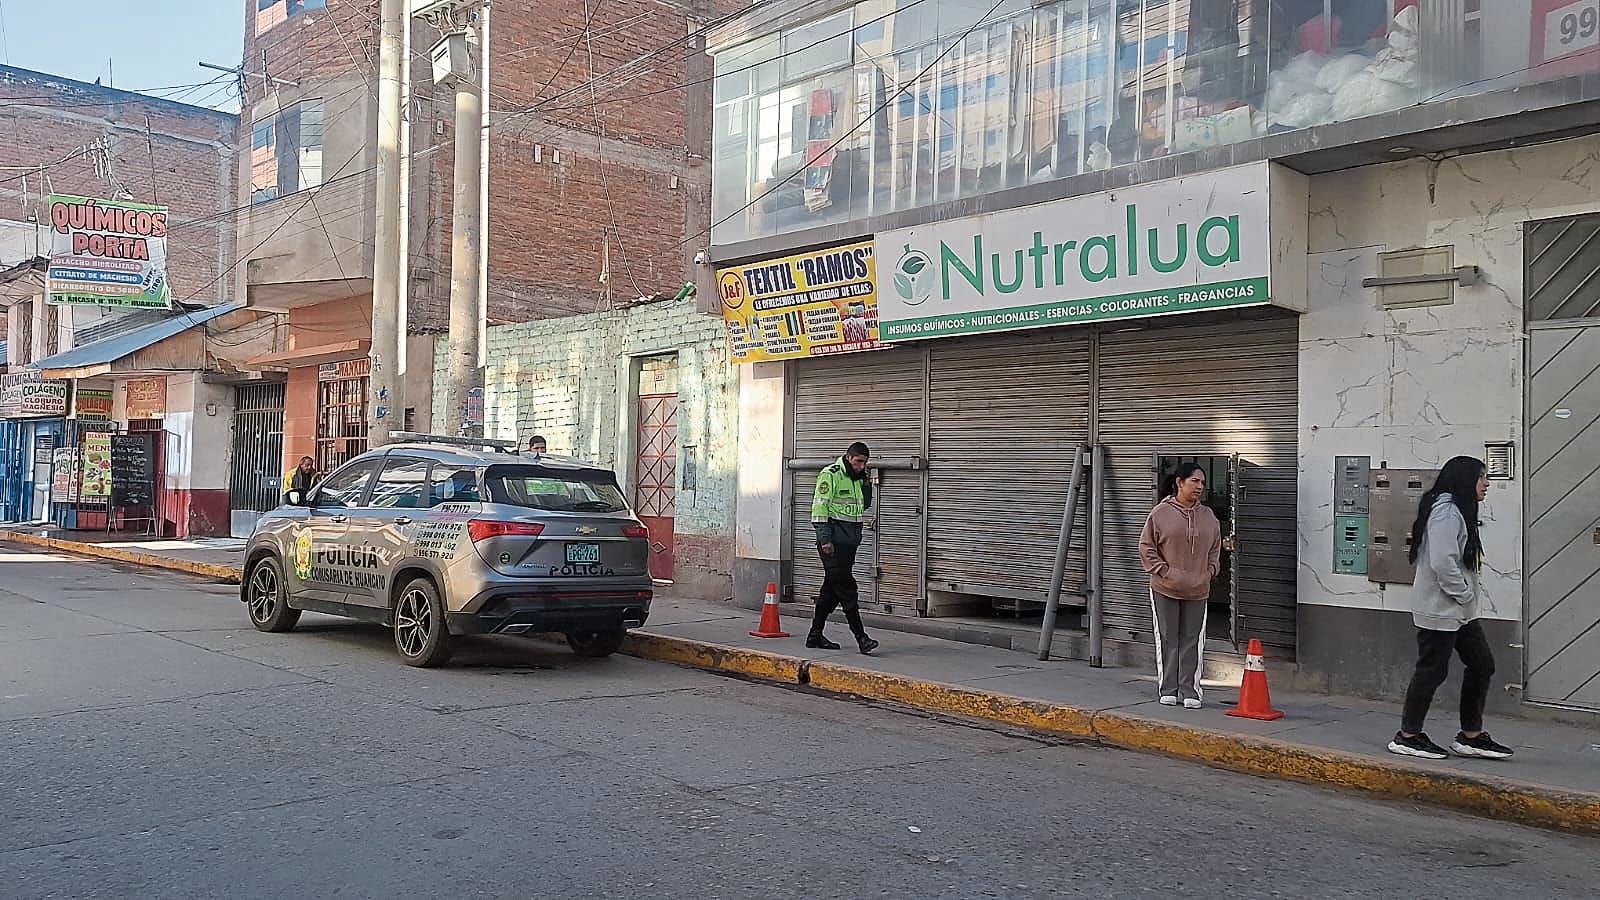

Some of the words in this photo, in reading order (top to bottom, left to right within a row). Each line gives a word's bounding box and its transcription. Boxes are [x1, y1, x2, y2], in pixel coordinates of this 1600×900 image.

[51, 199, 167, 237] QUÍMICOS
[73, 232, 150, 261] PORTA
[940, 204, 1241, 300] Nutralua
[55, 270, 86, 278] CITRATO
[100, 273, 138, 282] MAGNESIO
[744, 263, 796, 296] TEXTIL
[67, 296, 97, 304] ANCASH
[762, 295, 795, 309] OFRECEMOS
[796, 293, 809, 305] UNA
[809, 288, 840, 302] VARIEDAD
[841, 287, 851, 297] DE
[887, 324, 922, 335] INSUMOS
[923, 319, 965, 331] QUÍMICOS
[971, 310, 1040, 327] NUTRICIONALES
[1046, 304, 1093, 319] ESENCIAS
[1100, 295, 1169, 313] COLORANTES
[1178, 285, 1255, 304] FRAGANCIAS
[22, 384, 66, 398] COLÁGENO
[317, 540, 378, 569] POLICÍA
[344, 570, 353, 586] DE
[549, 563, 615, 576] POLICÍA
